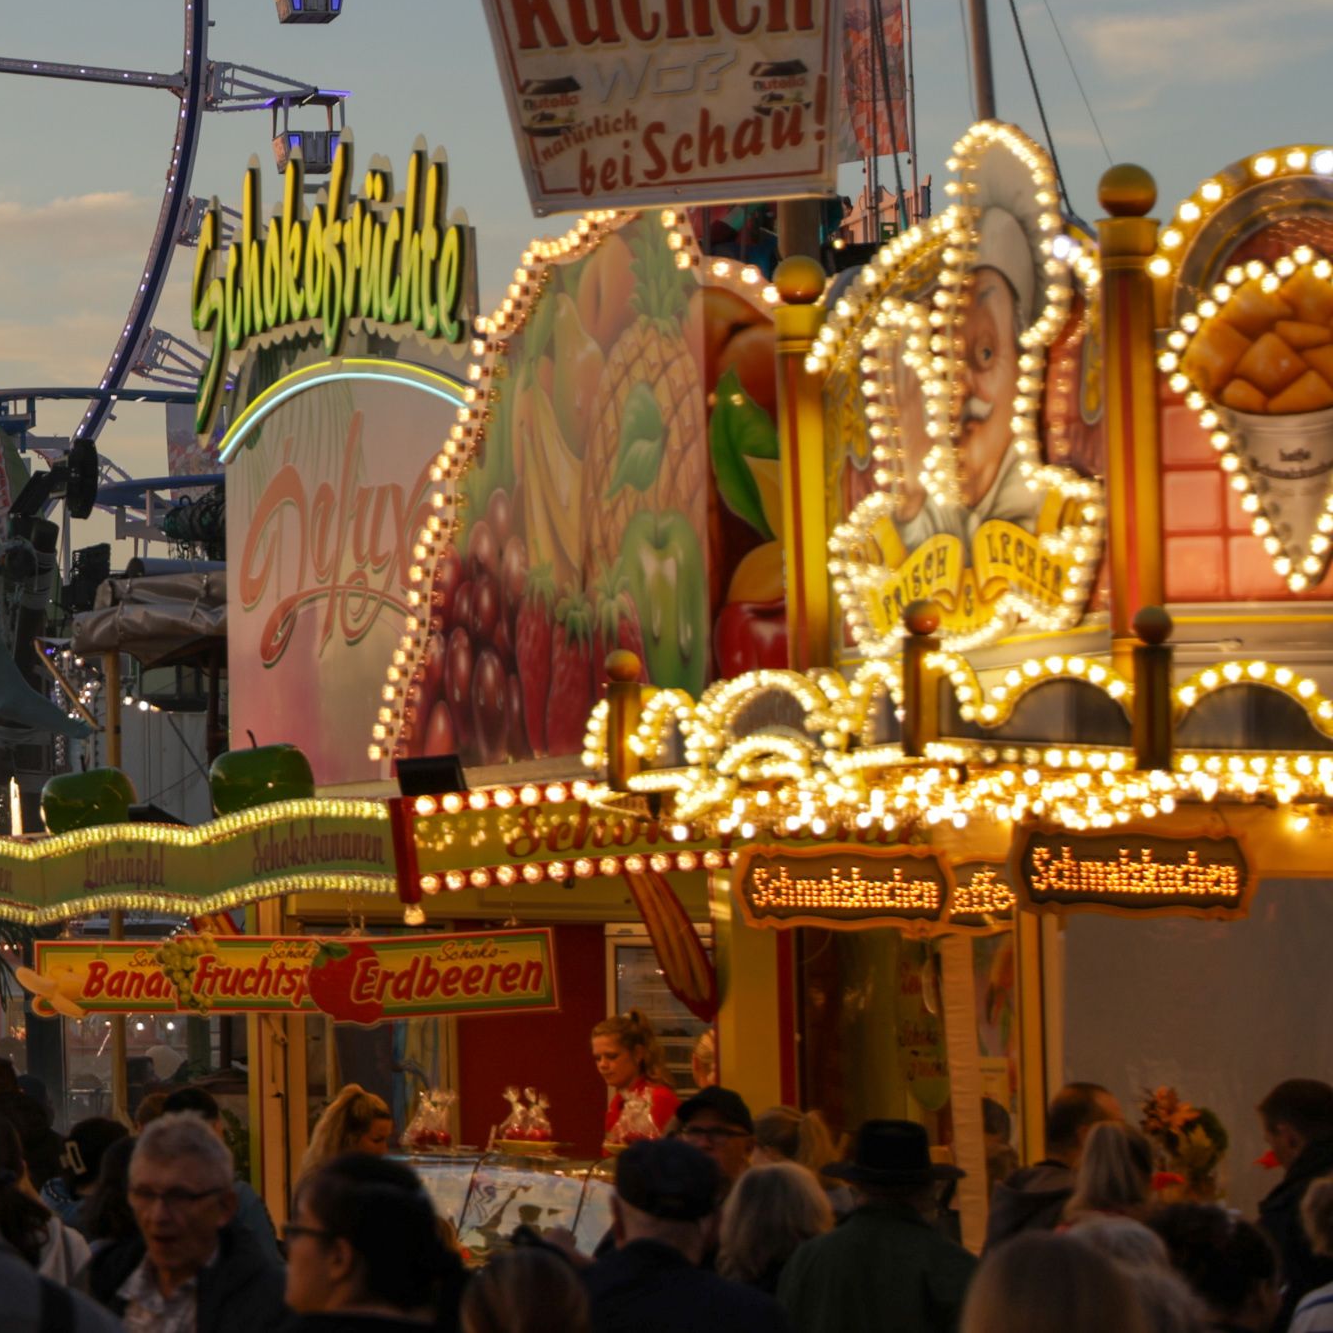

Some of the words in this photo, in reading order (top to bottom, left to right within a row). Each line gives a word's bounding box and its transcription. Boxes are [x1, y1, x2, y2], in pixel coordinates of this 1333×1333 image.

[540, 108, 638, 163] natürlich
[578, 140, 634, 197] bei
[642, 74, 829, 180] Schau!
[191, 141, 462, 435] Schokofrüchte
[239, 410, 438, 668] Delux
[753, 867, 939, 909] Schmalzkuchen
[1031, 846, 1238, 897] Schmalzkuchen
[349, 957, 545, 1007] Erdbeeren
